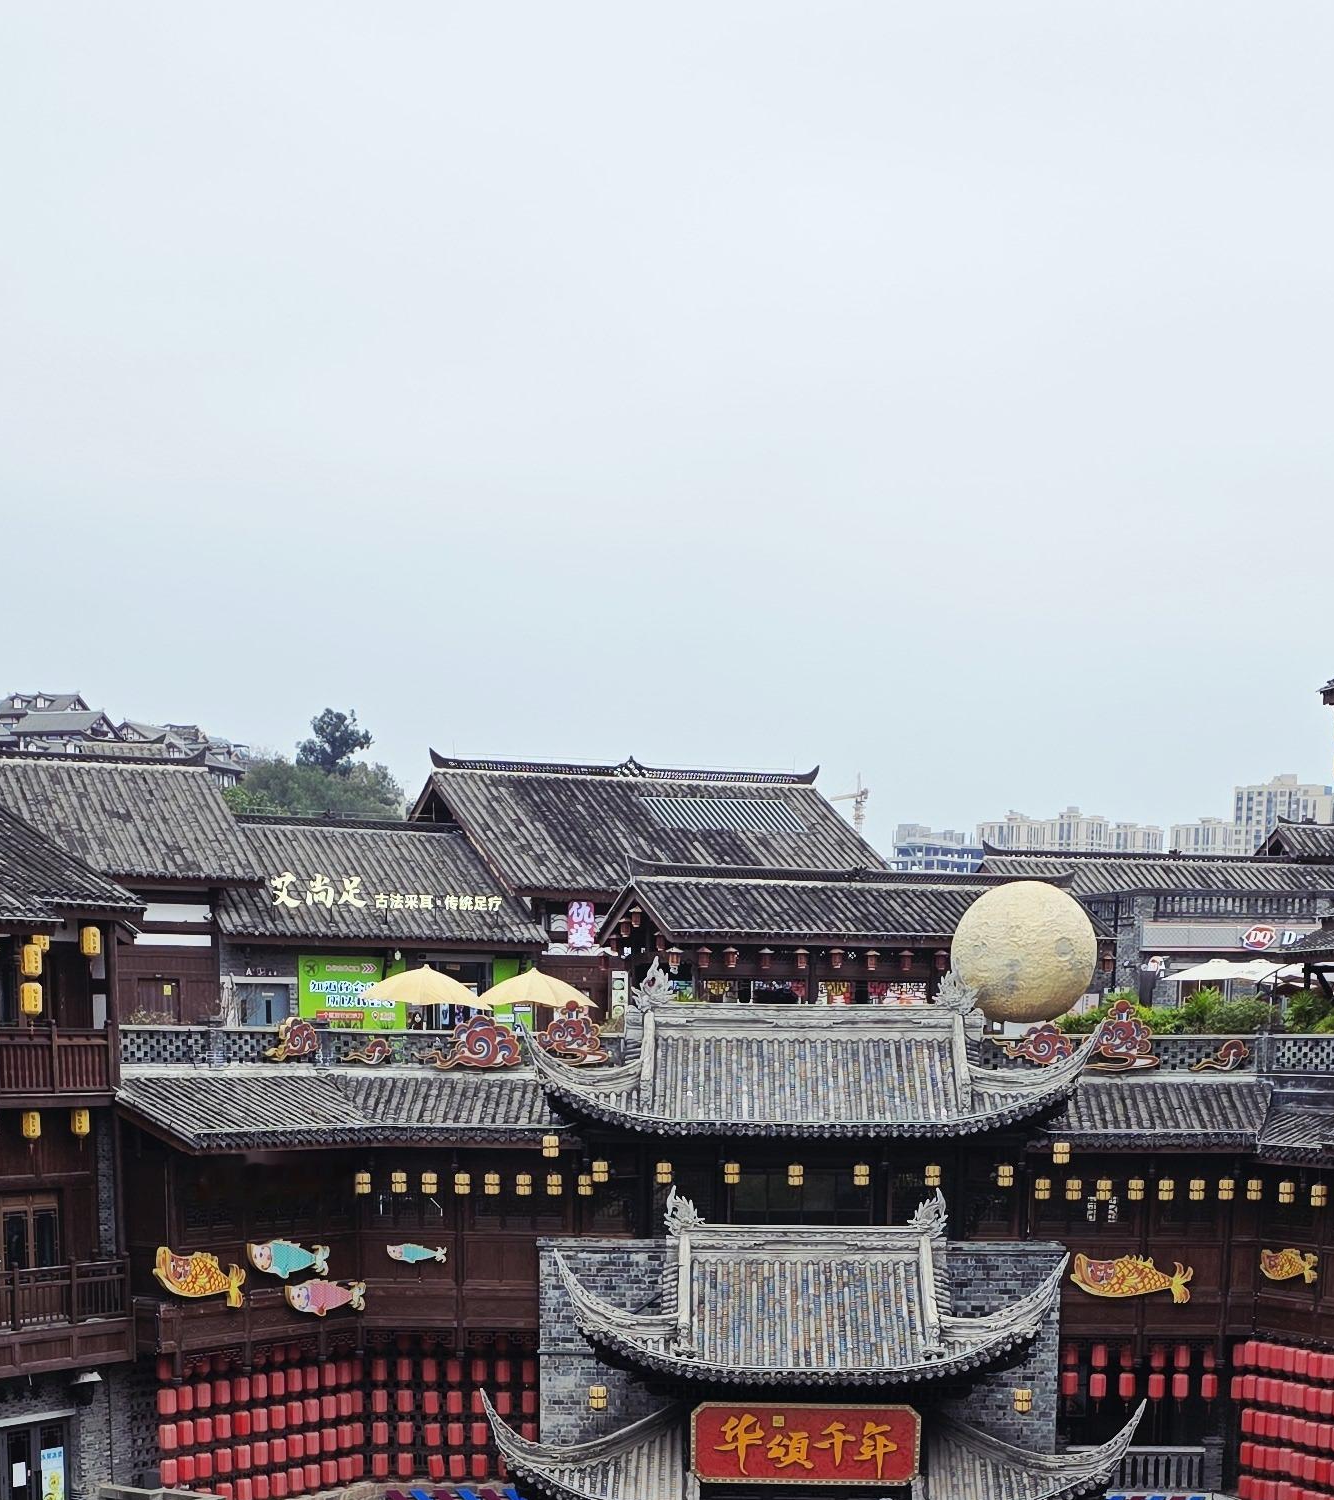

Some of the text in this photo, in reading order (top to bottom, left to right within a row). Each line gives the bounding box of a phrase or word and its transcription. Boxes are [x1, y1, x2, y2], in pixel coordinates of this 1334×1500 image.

[270, 871, 368, 909] 艾尚足
[1249, 929, 1272, 944] DQ
